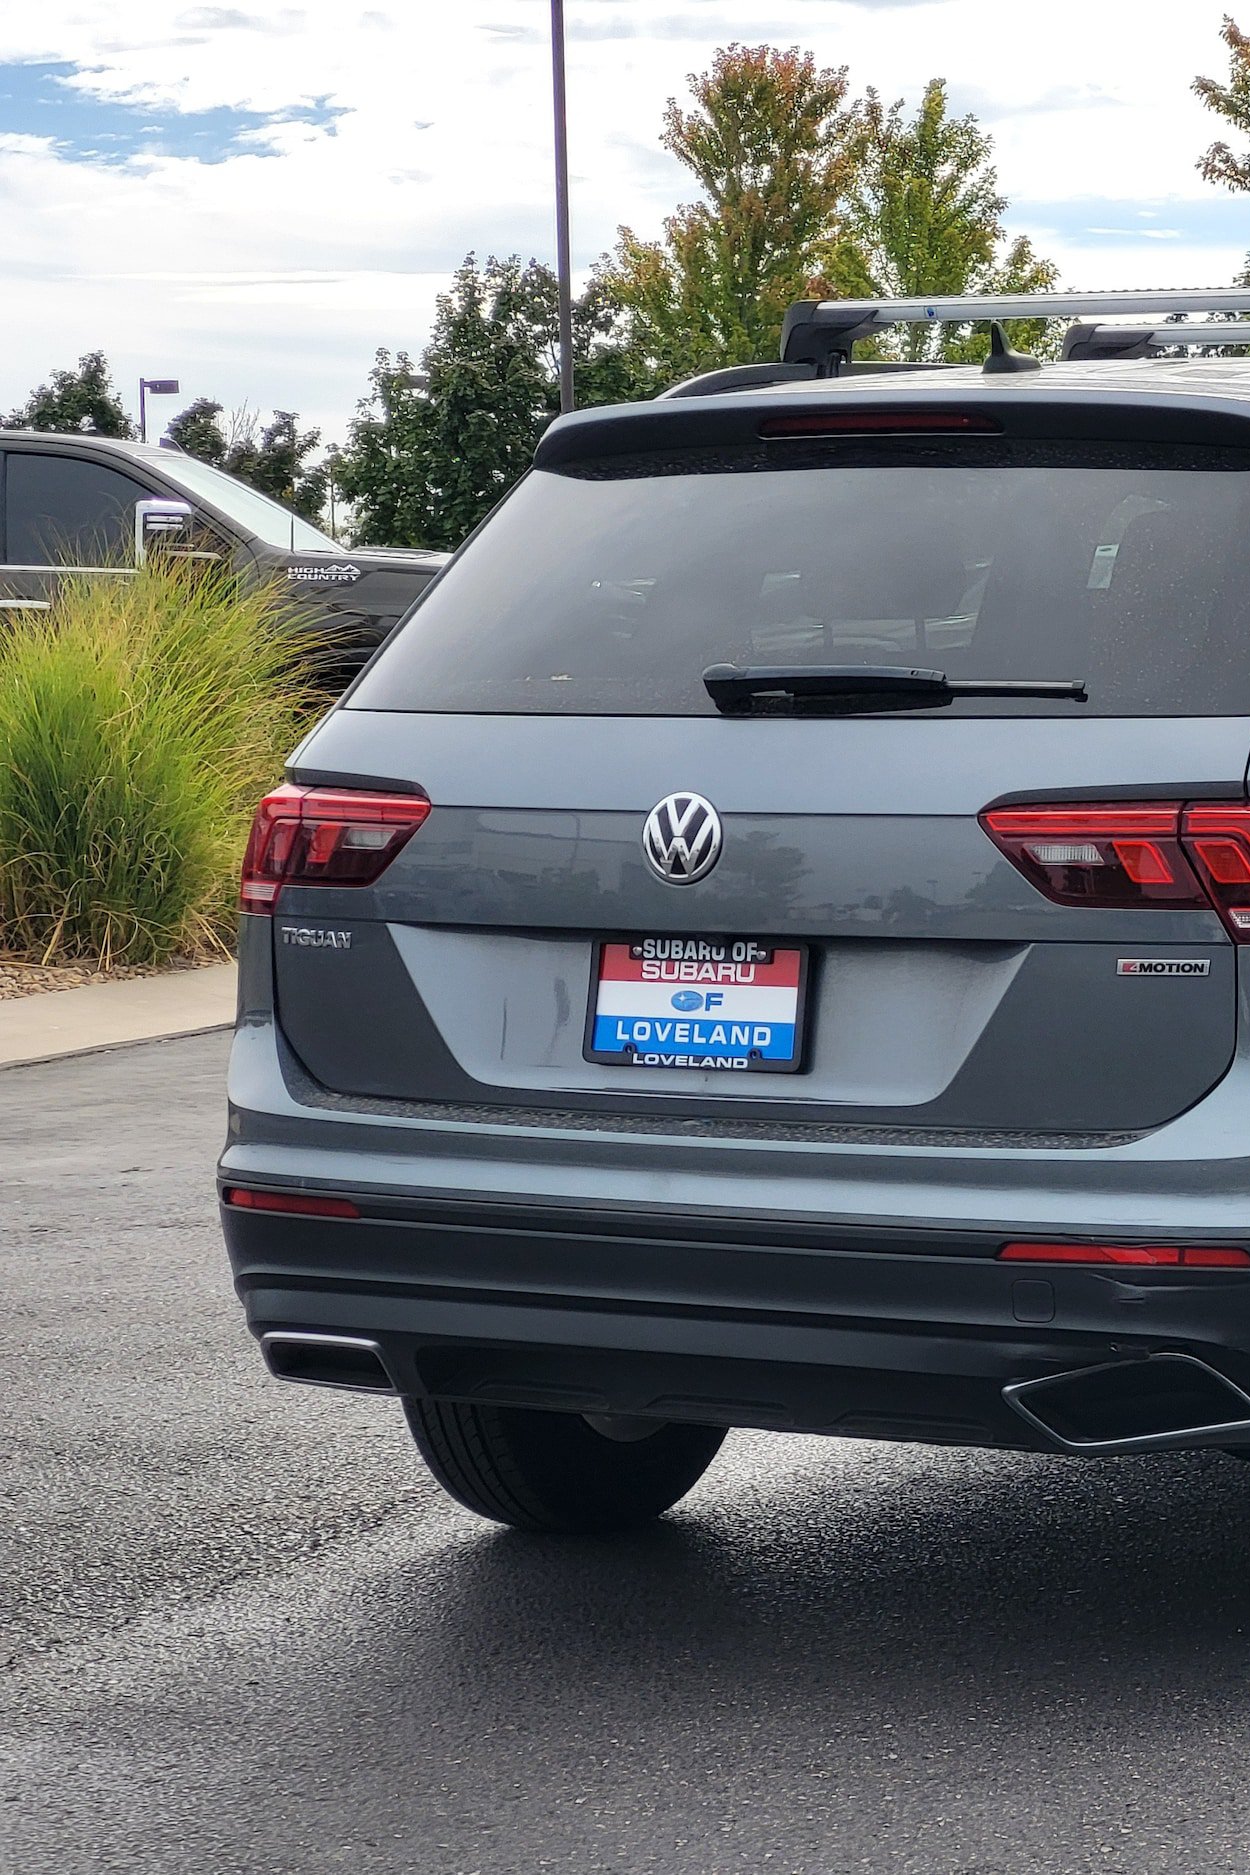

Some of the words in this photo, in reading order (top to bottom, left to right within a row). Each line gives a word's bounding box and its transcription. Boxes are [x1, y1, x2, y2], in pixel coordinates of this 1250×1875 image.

[287, 566, 325, 574] HIGH
[287, 573, 359, 581] COUNTRY
[281, 926, 352, 949] TIGUAN
[642, 939, 725, 961] SUBARU
[732, 942, 758, 962] OF
[641, 961, 756, 983] SUBARU
[616, 1020, 772, 1046] LOVELAND
[632, 1053, 748, 1069] LOVELAND
